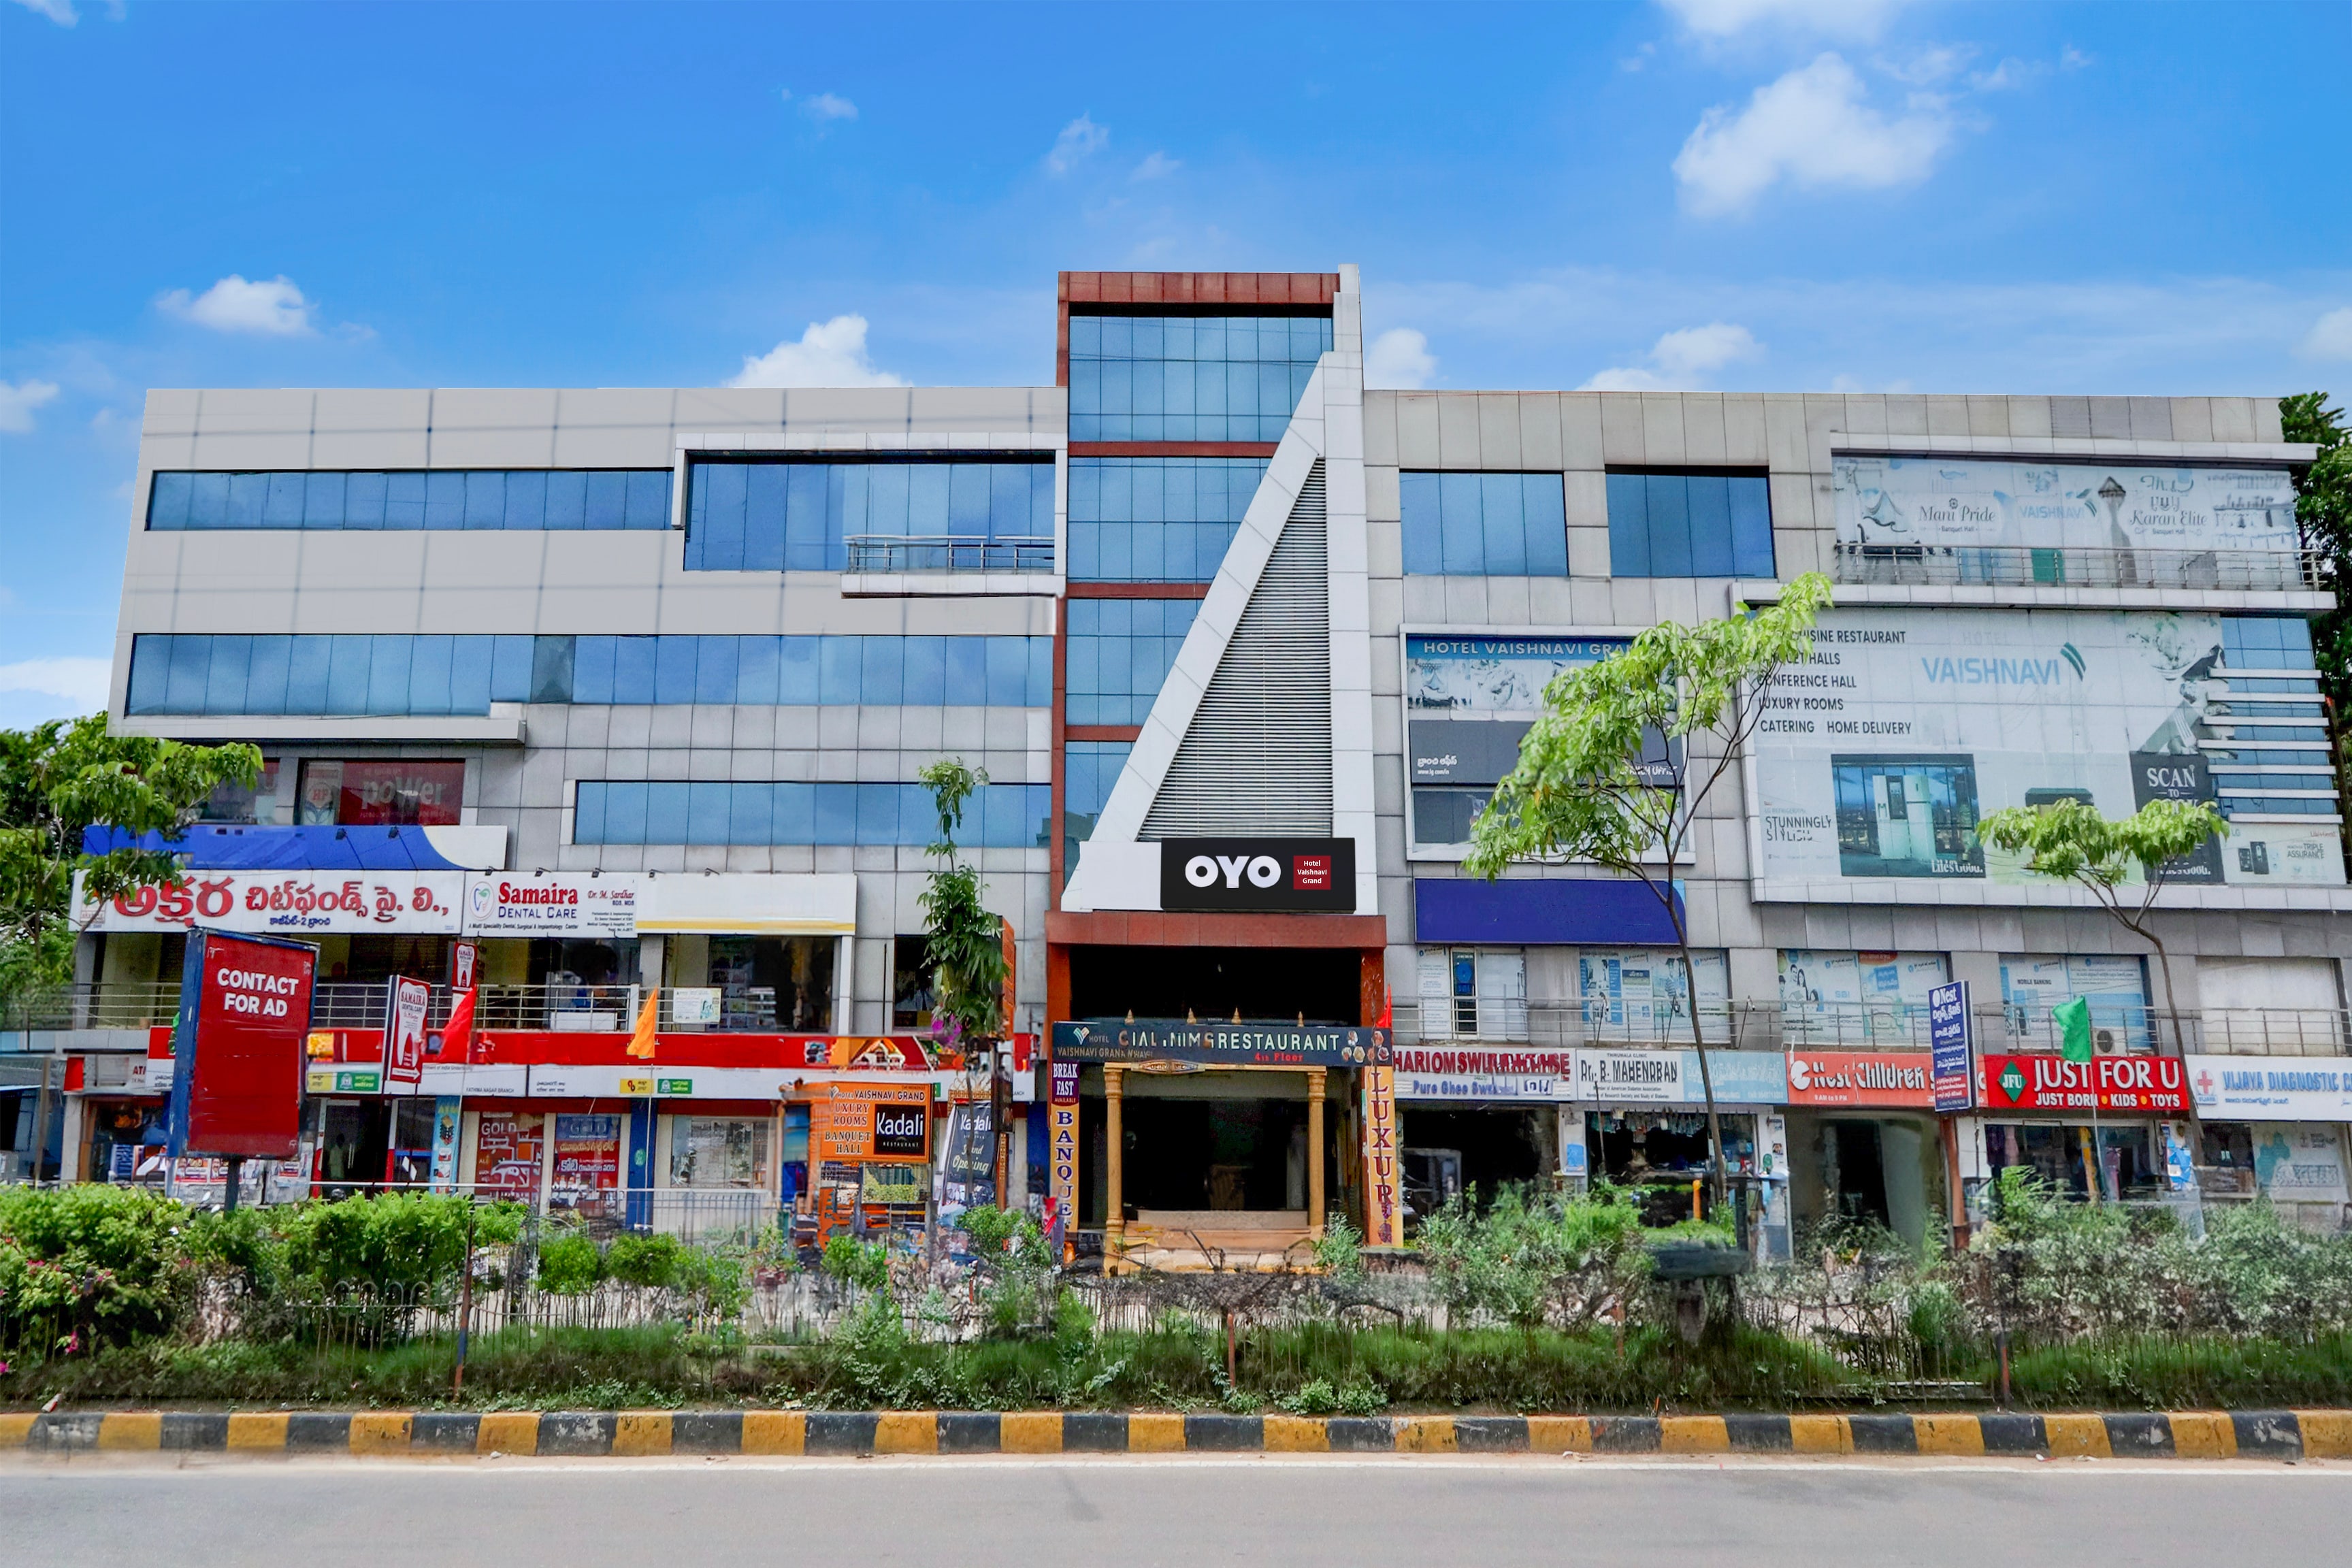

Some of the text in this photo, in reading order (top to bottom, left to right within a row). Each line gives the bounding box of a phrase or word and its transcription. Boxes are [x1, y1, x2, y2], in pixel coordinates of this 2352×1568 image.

[1918, 506, 1996, 521] Mani Pride
[2021, 506, 2084, 519] VAISHNAVI
[2129, 510, 2207, 525] Karan Elite
[1838, 630, 1906, 643] RESTAURANT
[1424, 642, 1478, 654] HOTEL
[1484, 642, 1582, 655] VAISHNAVI
[1810, 653, 1840, 665] HALLS
[1921, 657, 2061, 685] VAISHNAVI
[1757, 674, 1857, 688] CONFERENCE HALL
[1759, 696, 1844, 710] LUXURY ROOMS
[1761, 720, 1912, 735] CATERING HOME DELIVERY
[2147, 766, 2196, 787] SCAN
[361, 776, 446, 809] power
[1765, 815, 1831, 828] STUNNINGLY
[2287, 850, 2325, 860] ASSURANCE
[1186, 855, 1281, 889] OYO
[498, 882, 578, 905] Samaira
[587, 890, 598, 899] Dr.
[498, 906, 577, 919] DENTAL CARE
[217, 968, 299, 996] CONTACT
[401, 991, 425, 1007] SAMAIRA
[1940, 986, 1957, 1004] Nest
[224, 992, 288, 1017] FOR AD
[1089, 1035, 1109, 1043] HOTEL
[1218, 1032, 1339, 1051] RESTAURANT
[1058, 1047, 1098, 1057] VAISHNAVI
[1274, 1053, 1304, 1062] Floor
[133, 1066, 146, 1075] AT
[1053, 1063, 1077, 1078] BREAK
[2034, 1060, 2178, 1092] JUST FOR U
[1056, 1081, 1074, 1096] FAST
[1414, 1080, 1469, 1095] Pure Ghee
[2002, 1074, 2023, 1089] JFU
[2222, 1071, 2340, 1092] VIJAYA DIAGNOSTIC
[855, 1090, 895, 1100] VAISHNAVI
[898, 1091, 925, 1101] GRAND
[2036, 1092, 2180, 1107] JUST BORN KIDS TOYS
[834, 1103, 870, 1114] UXURY
[834, 1115, 868, 1126] ROOMS
[877, 1112, 924, 1136] Kadali
[481, 1122, 517, 1135] GOLD
[825, 1131, 871, 1142] BANQUET
[836, 1144, 862, 1154] HALL
